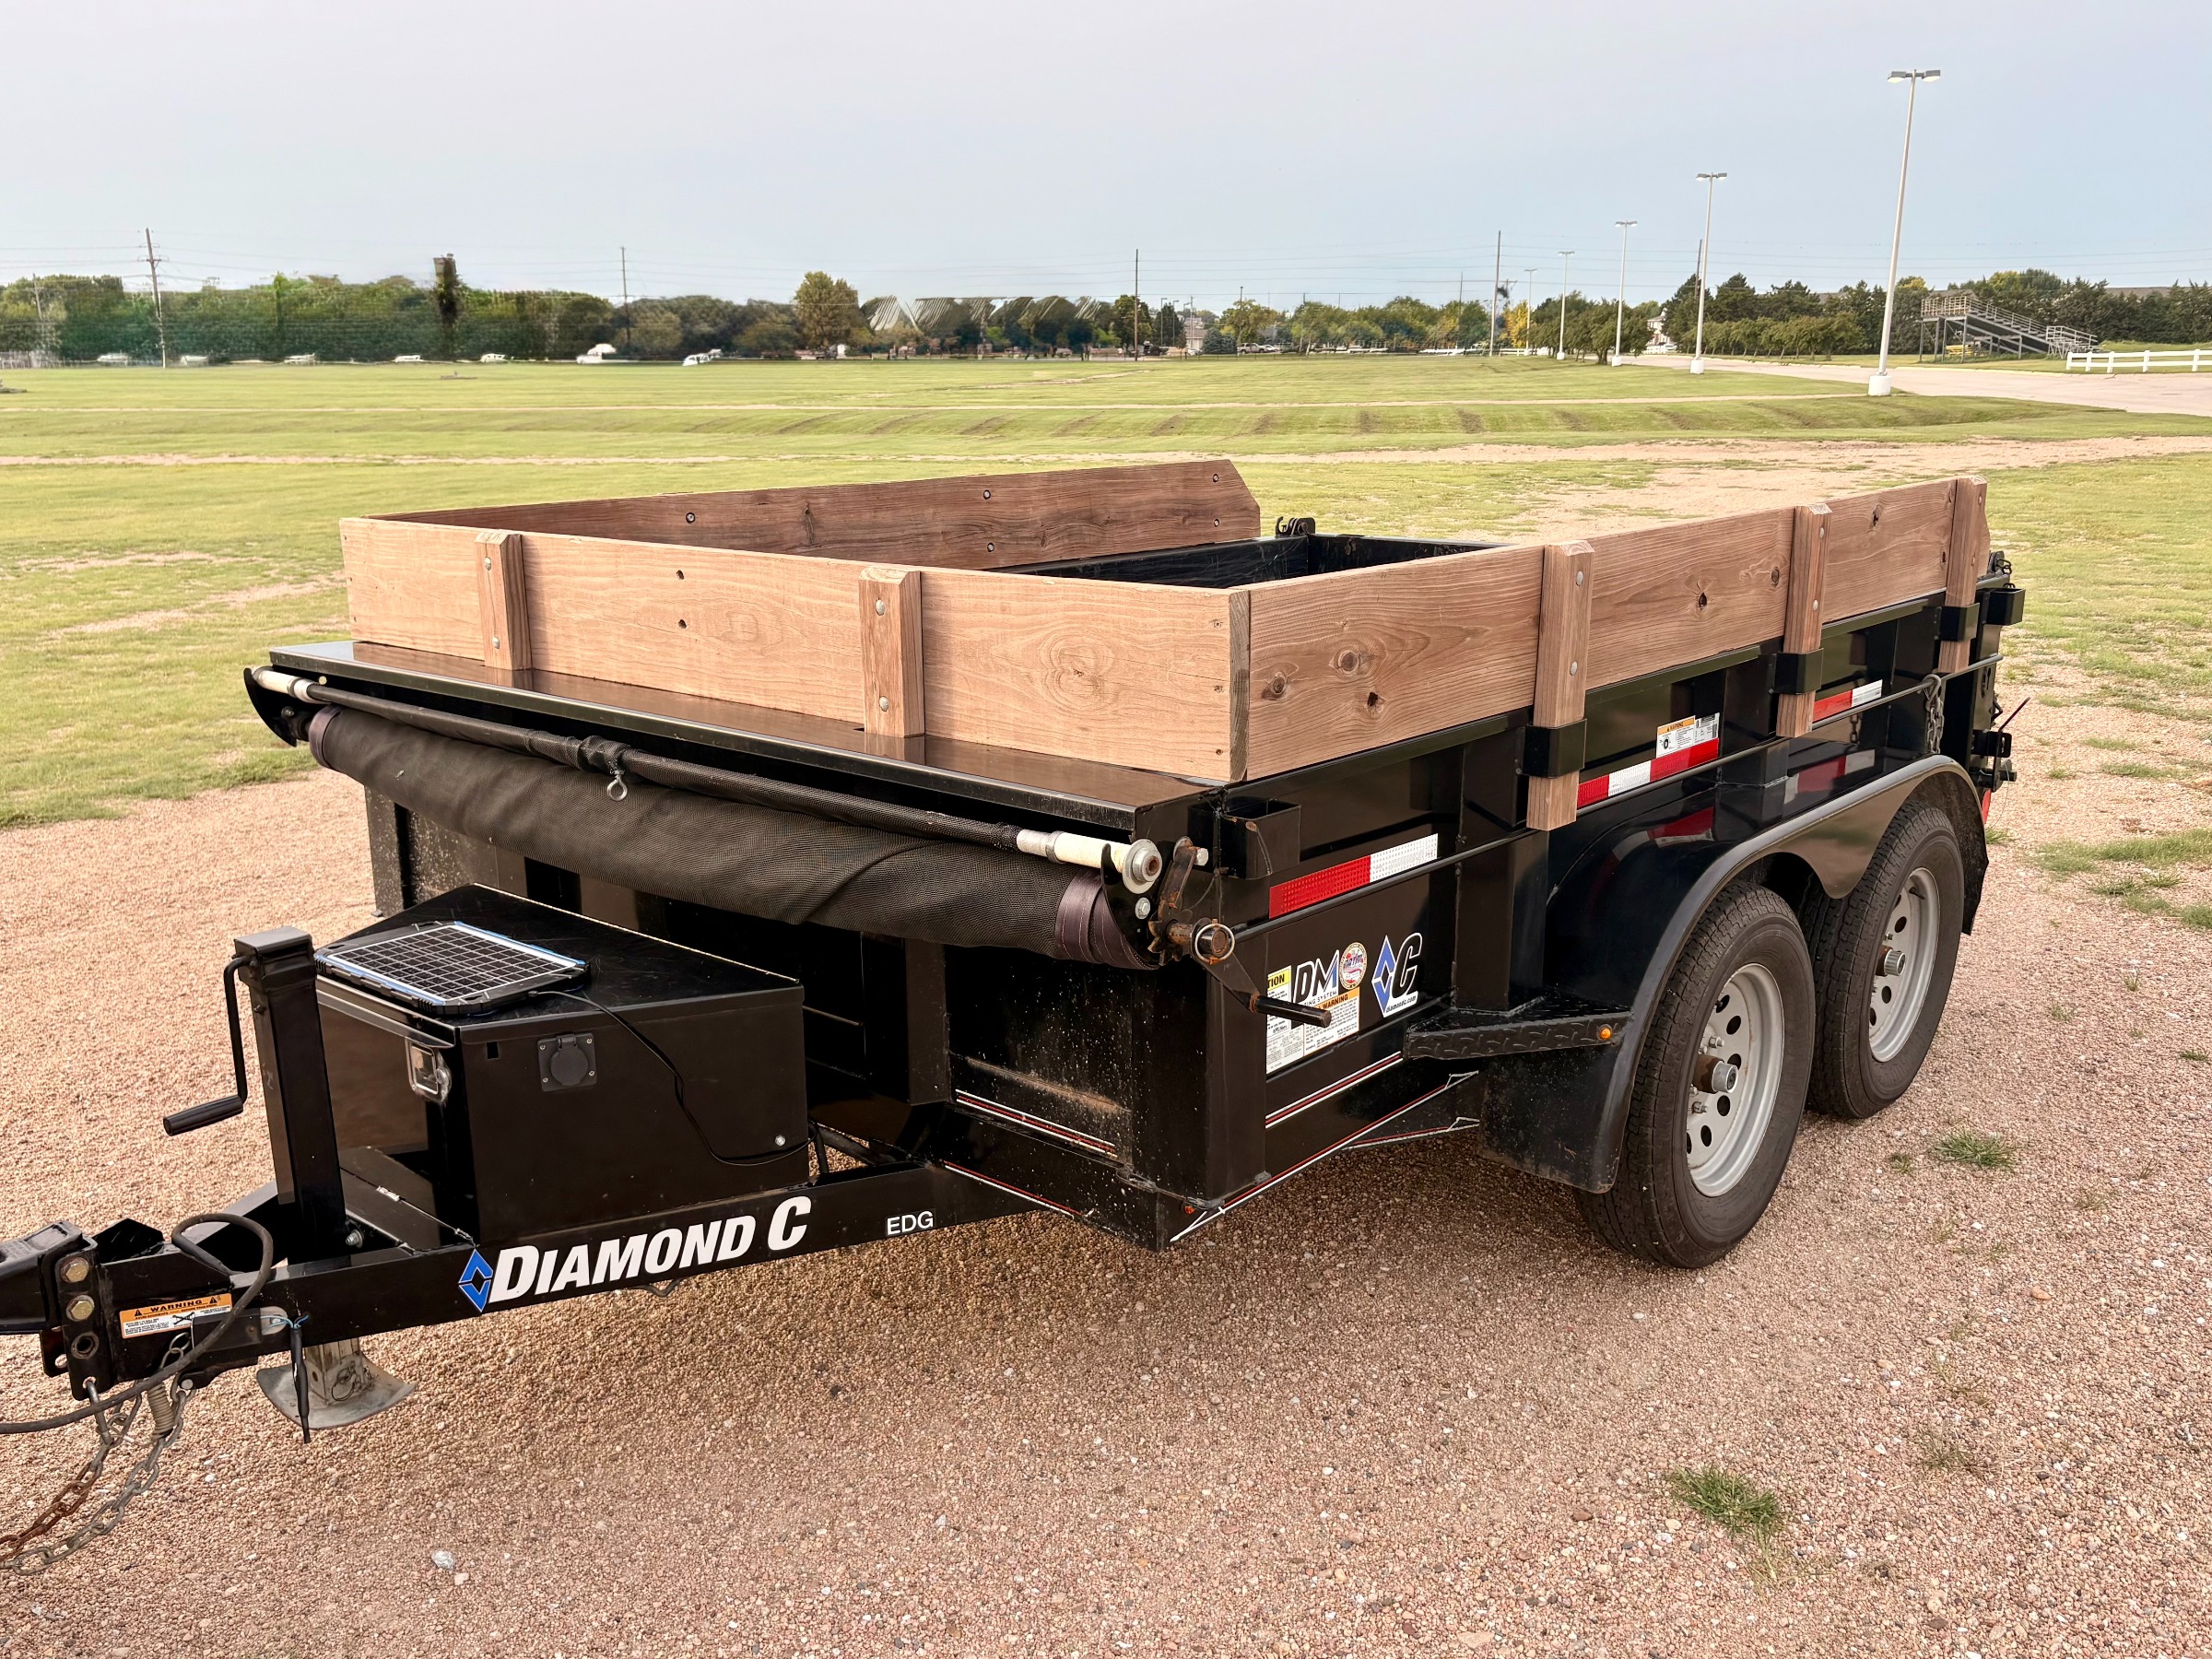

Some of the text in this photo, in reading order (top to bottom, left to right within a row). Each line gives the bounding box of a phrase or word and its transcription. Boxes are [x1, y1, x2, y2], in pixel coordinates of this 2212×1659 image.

[1323, 994, 1348, 1010] WARNING
[1385, 995, 1417, 1013] diamondc.com
[887, 1211, 935, 1235] EDG
[488, 1195, 812, 1303] DIAMOND C
[150, 1300, 203, 1312] WARNING
